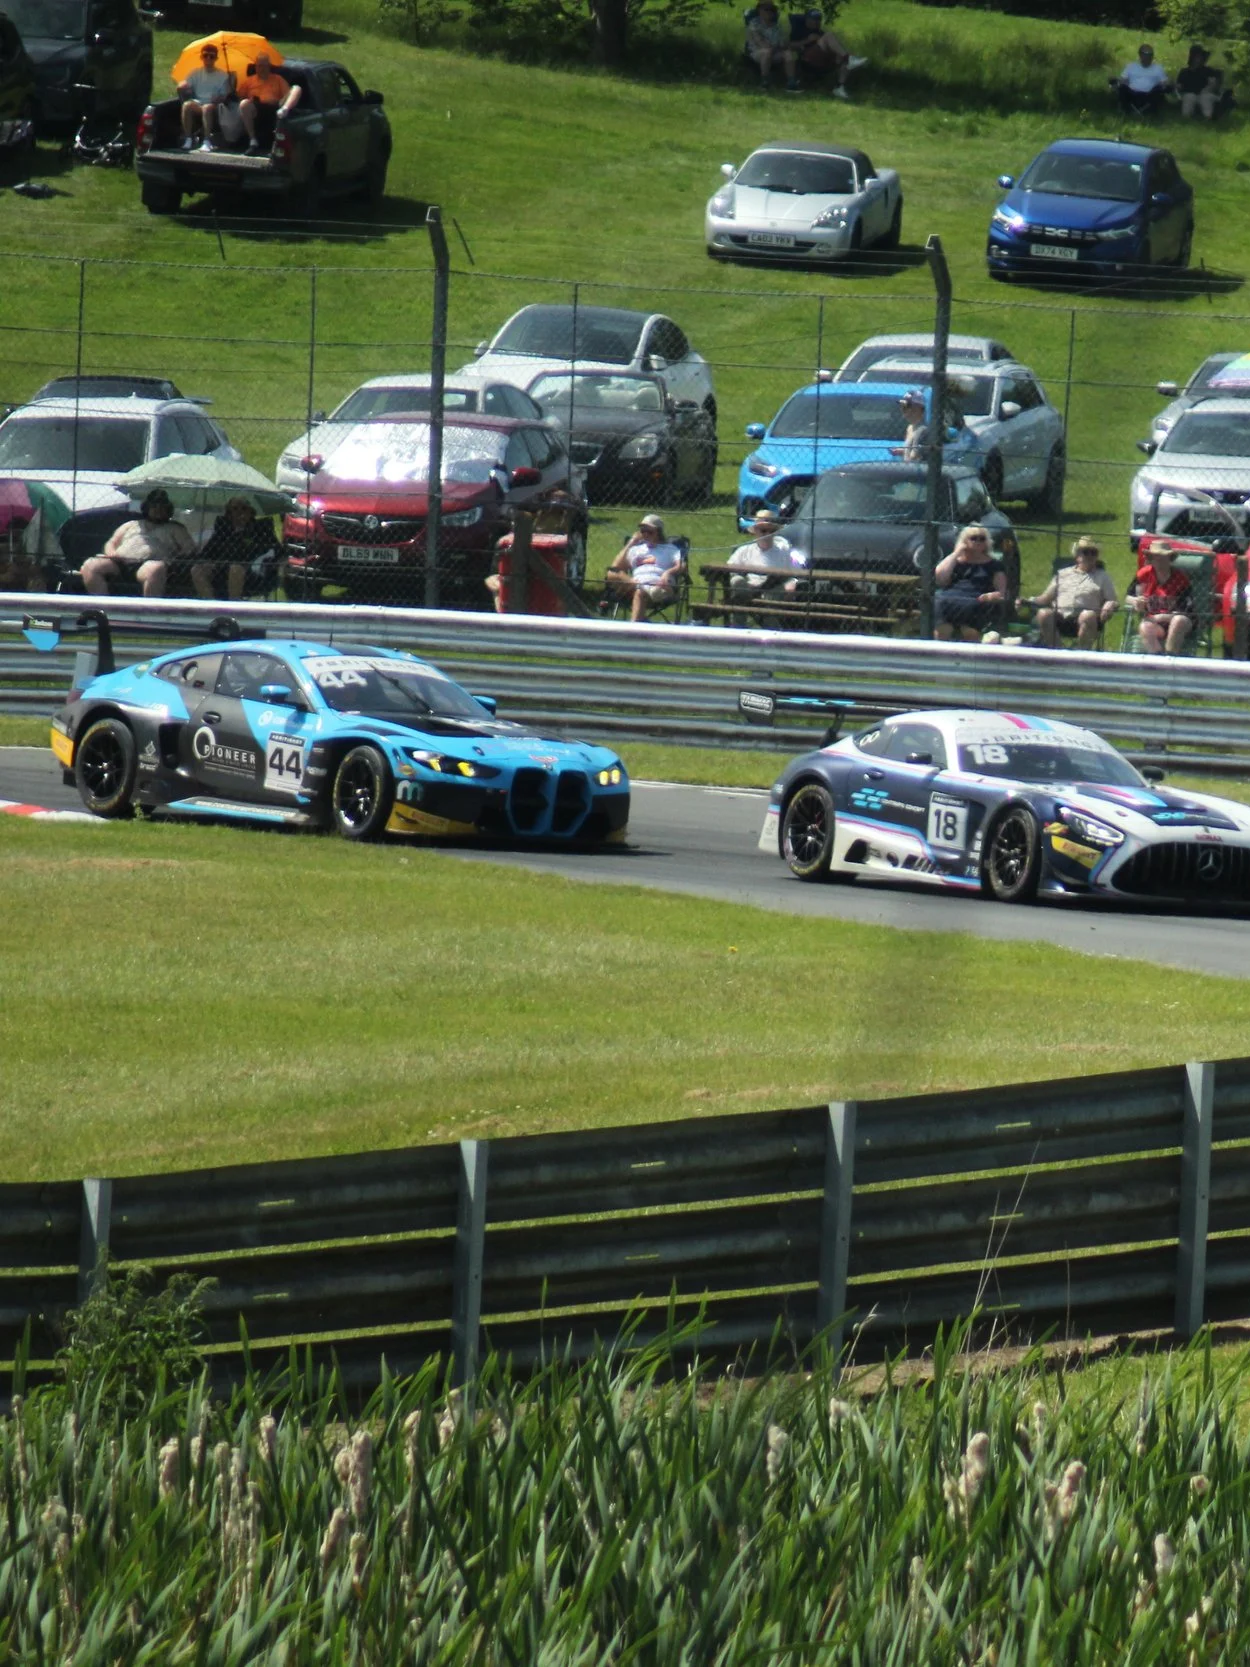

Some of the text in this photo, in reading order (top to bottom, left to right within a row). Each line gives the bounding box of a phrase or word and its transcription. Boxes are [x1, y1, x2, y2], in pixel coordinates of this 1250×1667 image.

[319, 670, 368, 688] 44
[204, 744, 256, 765] PIONEER
[269, 747, 303, 780] 44
[966, 744, 1009, 765] 18
[934, 808, 957, 841] 18
